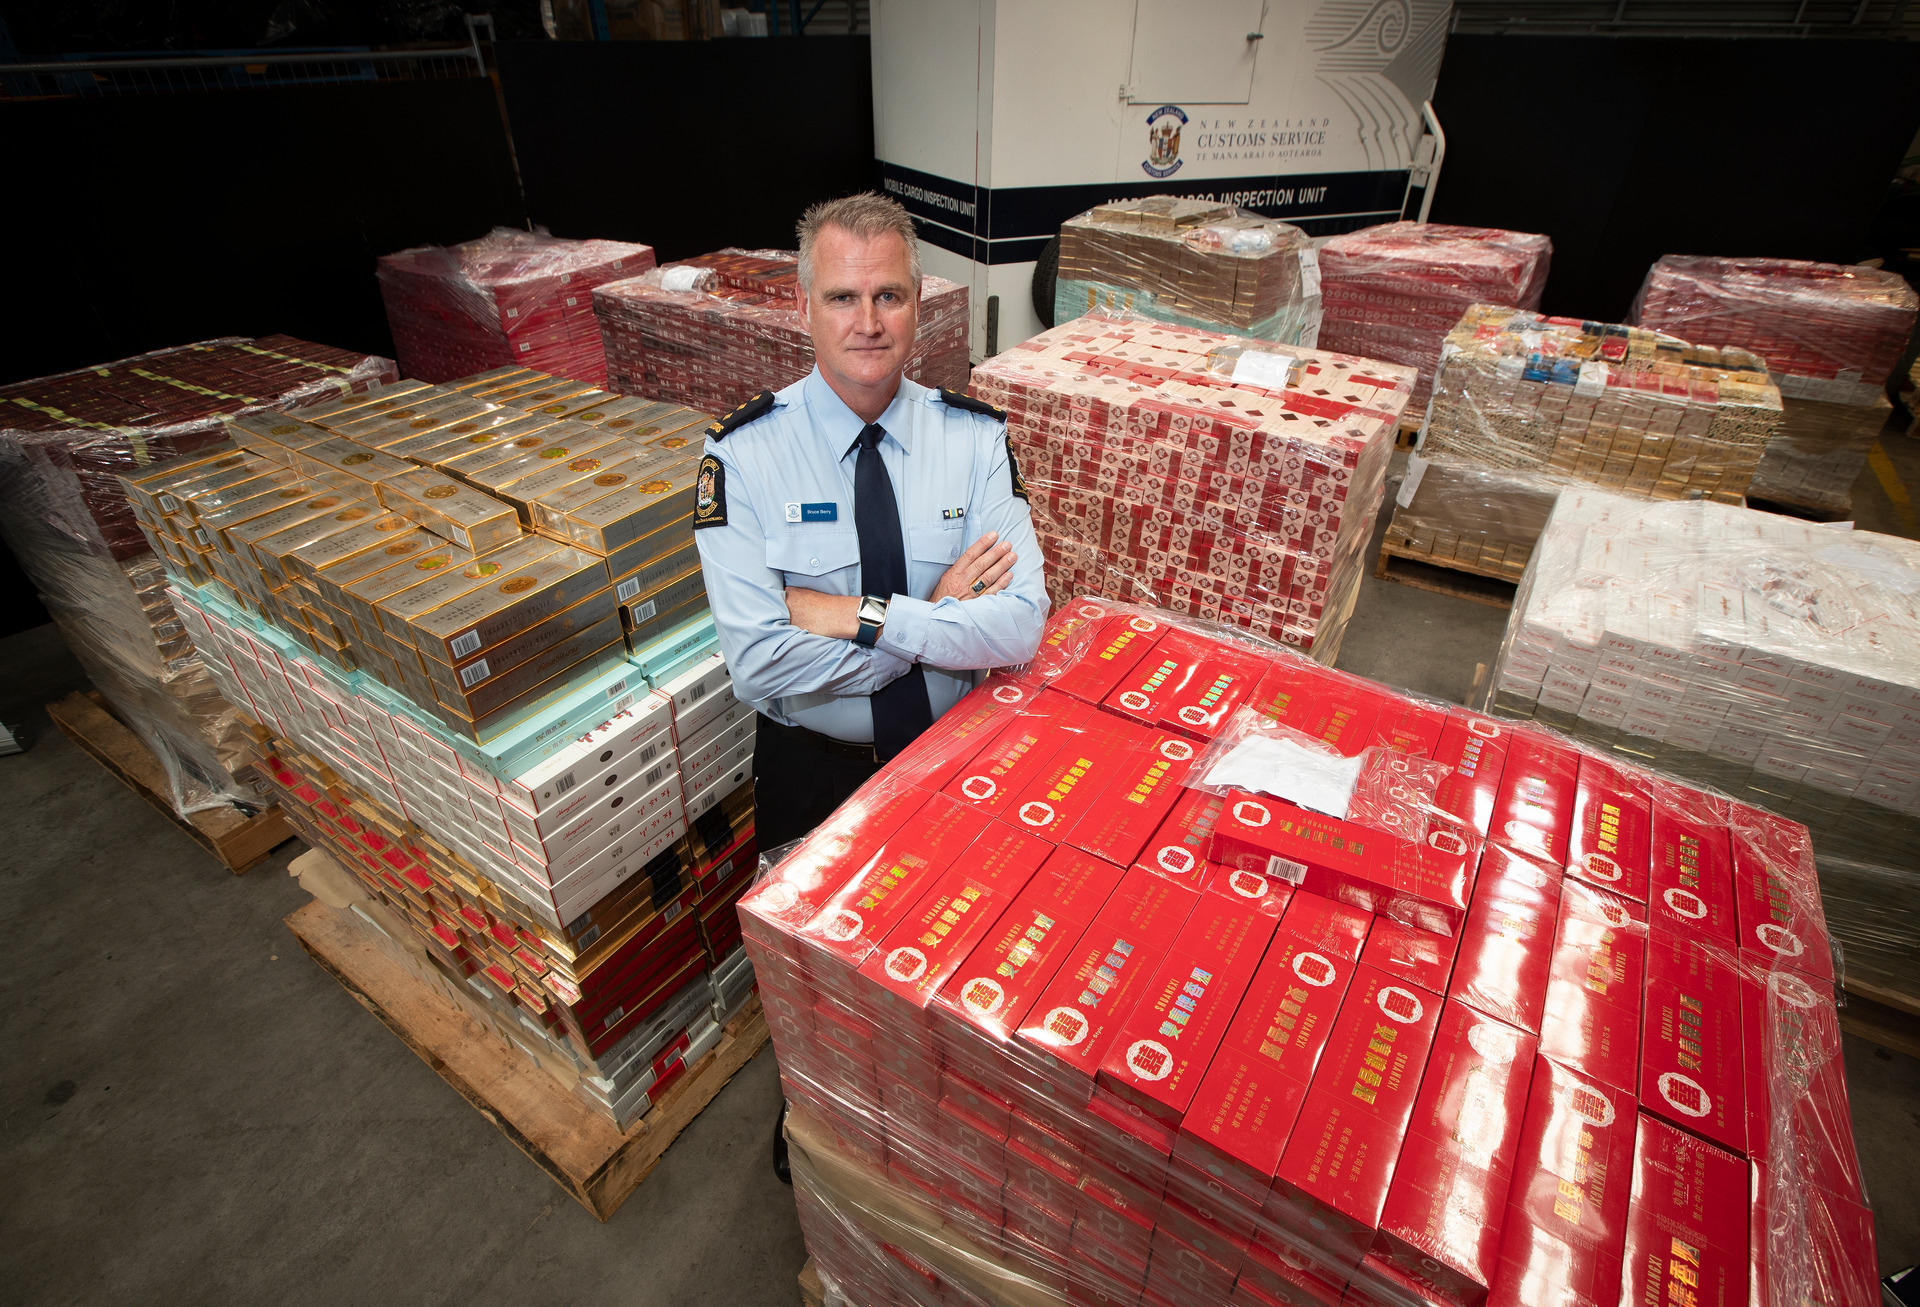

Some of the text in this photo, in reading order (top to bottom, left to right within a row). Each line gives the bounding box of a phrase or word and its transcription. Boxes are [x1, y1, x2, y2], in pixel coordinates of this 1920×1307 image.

[1197, 131, 1327, 148] CUSTOMS SERVICE
[1200, 118, 1330, 129] NEW ZEALAND
[1196, 153, 1208, 161] TE
[1212, 152, 1239, 161] MANA
[1276, 149, 1323, 159] AOTEAROA
[884, 178, 976, 217] MOBILE CARGO INSPECTION UNIT
[1220, 189, 1296, 208] INSPECTION
[1298, 187, 1328, 205] UNIT
[1302, 818, 1342, 834] SHUANGXI
[921, 894, 950, 924] SHUANGXI
[995, 923, 1022, 954] SHUANGXI
[1075, 949, 1101, 981] SHUANGXI
[1614, 951, 1627, 984] SHUANGXI
[1154, 978, 1180, 1012] SHUANGXI
[1295, 1013, 1318, 1049] SHUANGXI
[1661, 1006, 1674, 1042] SHUANGXI
[1387, 1052, 1408, 1091] SHUANGXI
[1590, 1161, 1607, 1209] SHUANGXI
